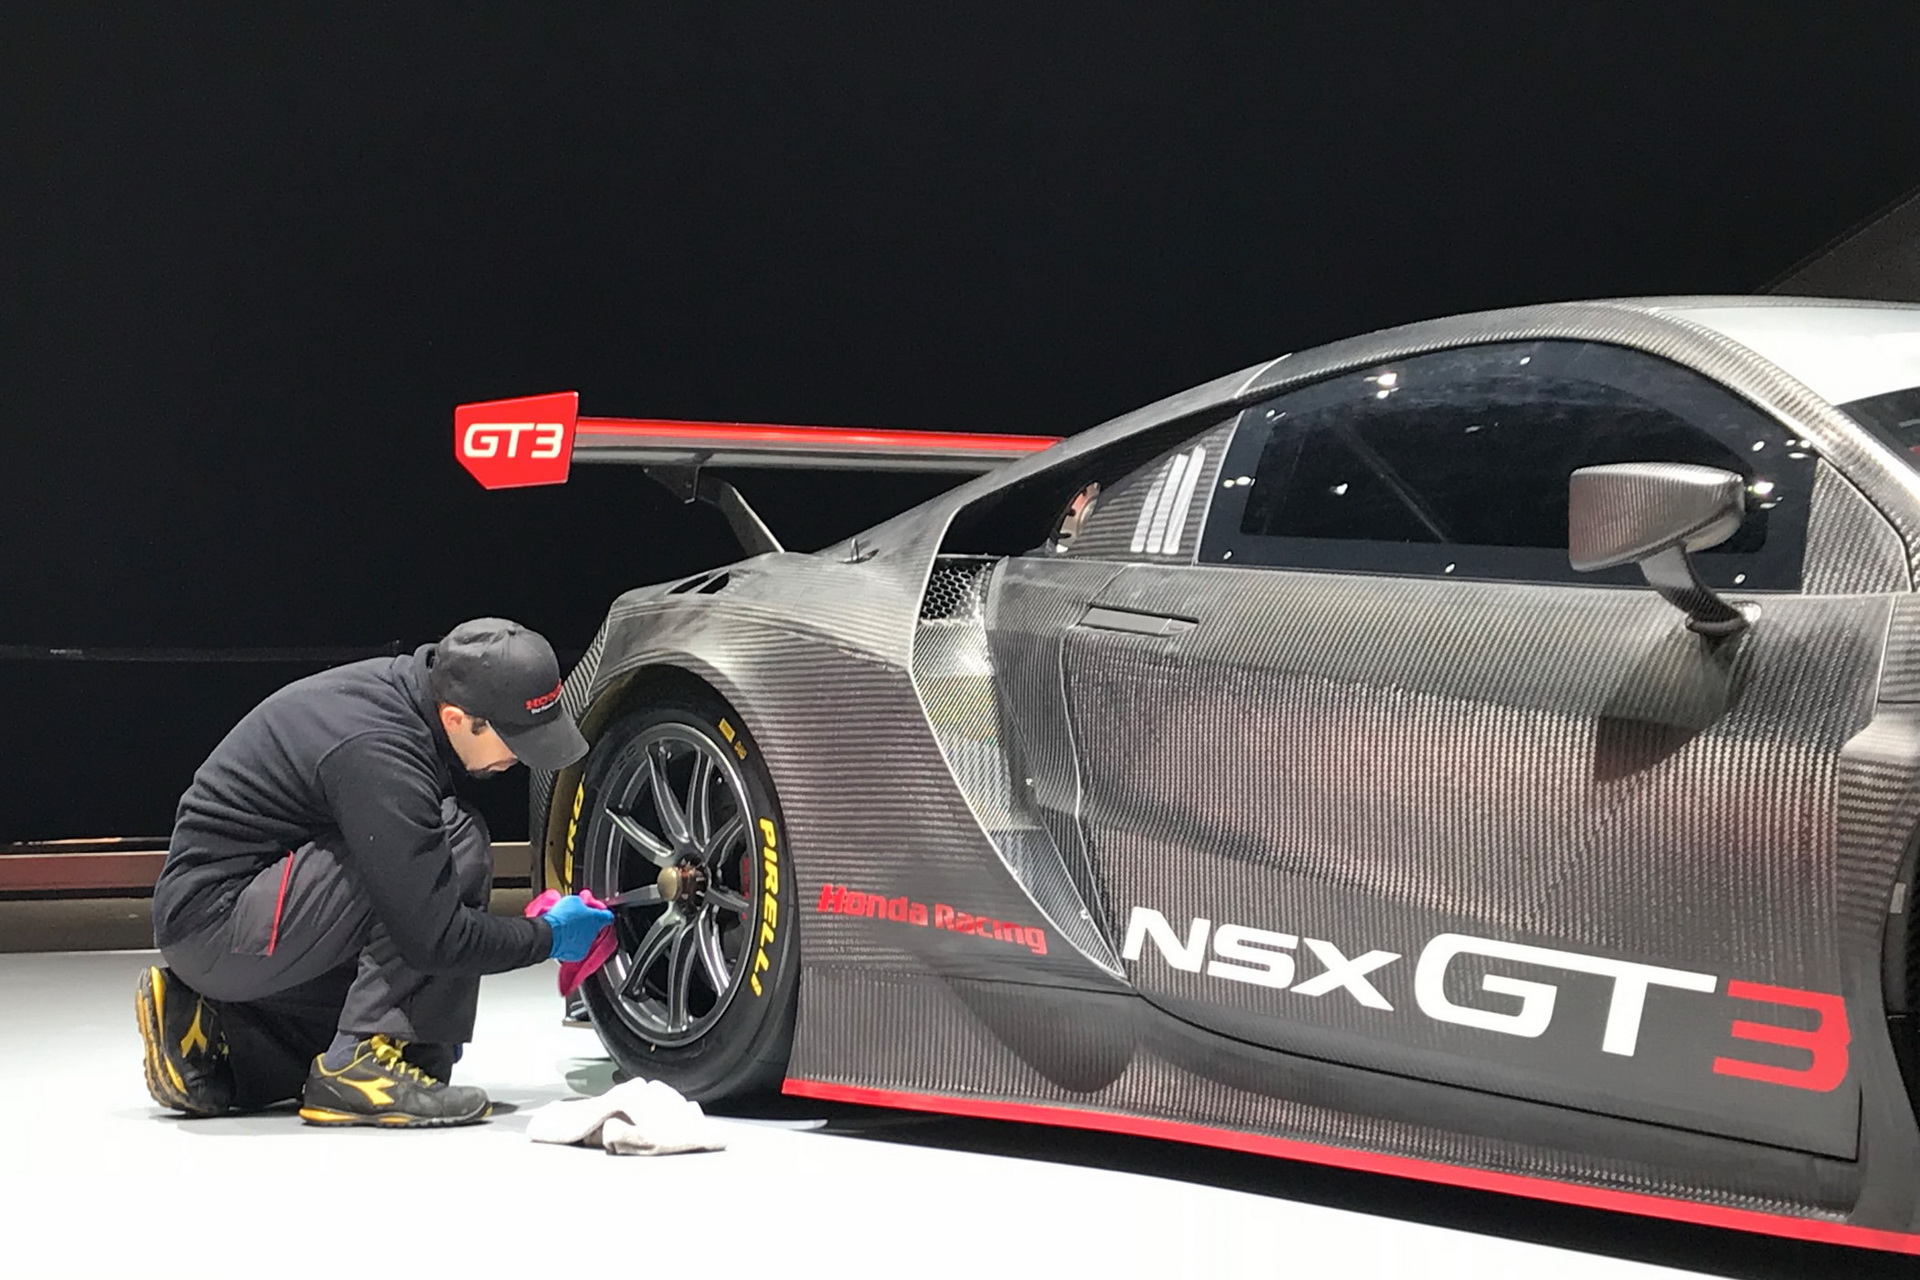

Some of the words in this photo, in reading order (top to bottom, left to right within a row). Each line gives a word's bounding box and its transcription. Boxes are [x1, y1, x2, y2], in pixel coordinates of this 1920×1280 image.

[463, 422, 564, 458] GT3
[751, 818, 779, 997] PIRELLI
[816, 882, 929, 927] Honda
[934, 902, 1048, 956] Racing
[1122, 906, 1403, 1011] NSX
